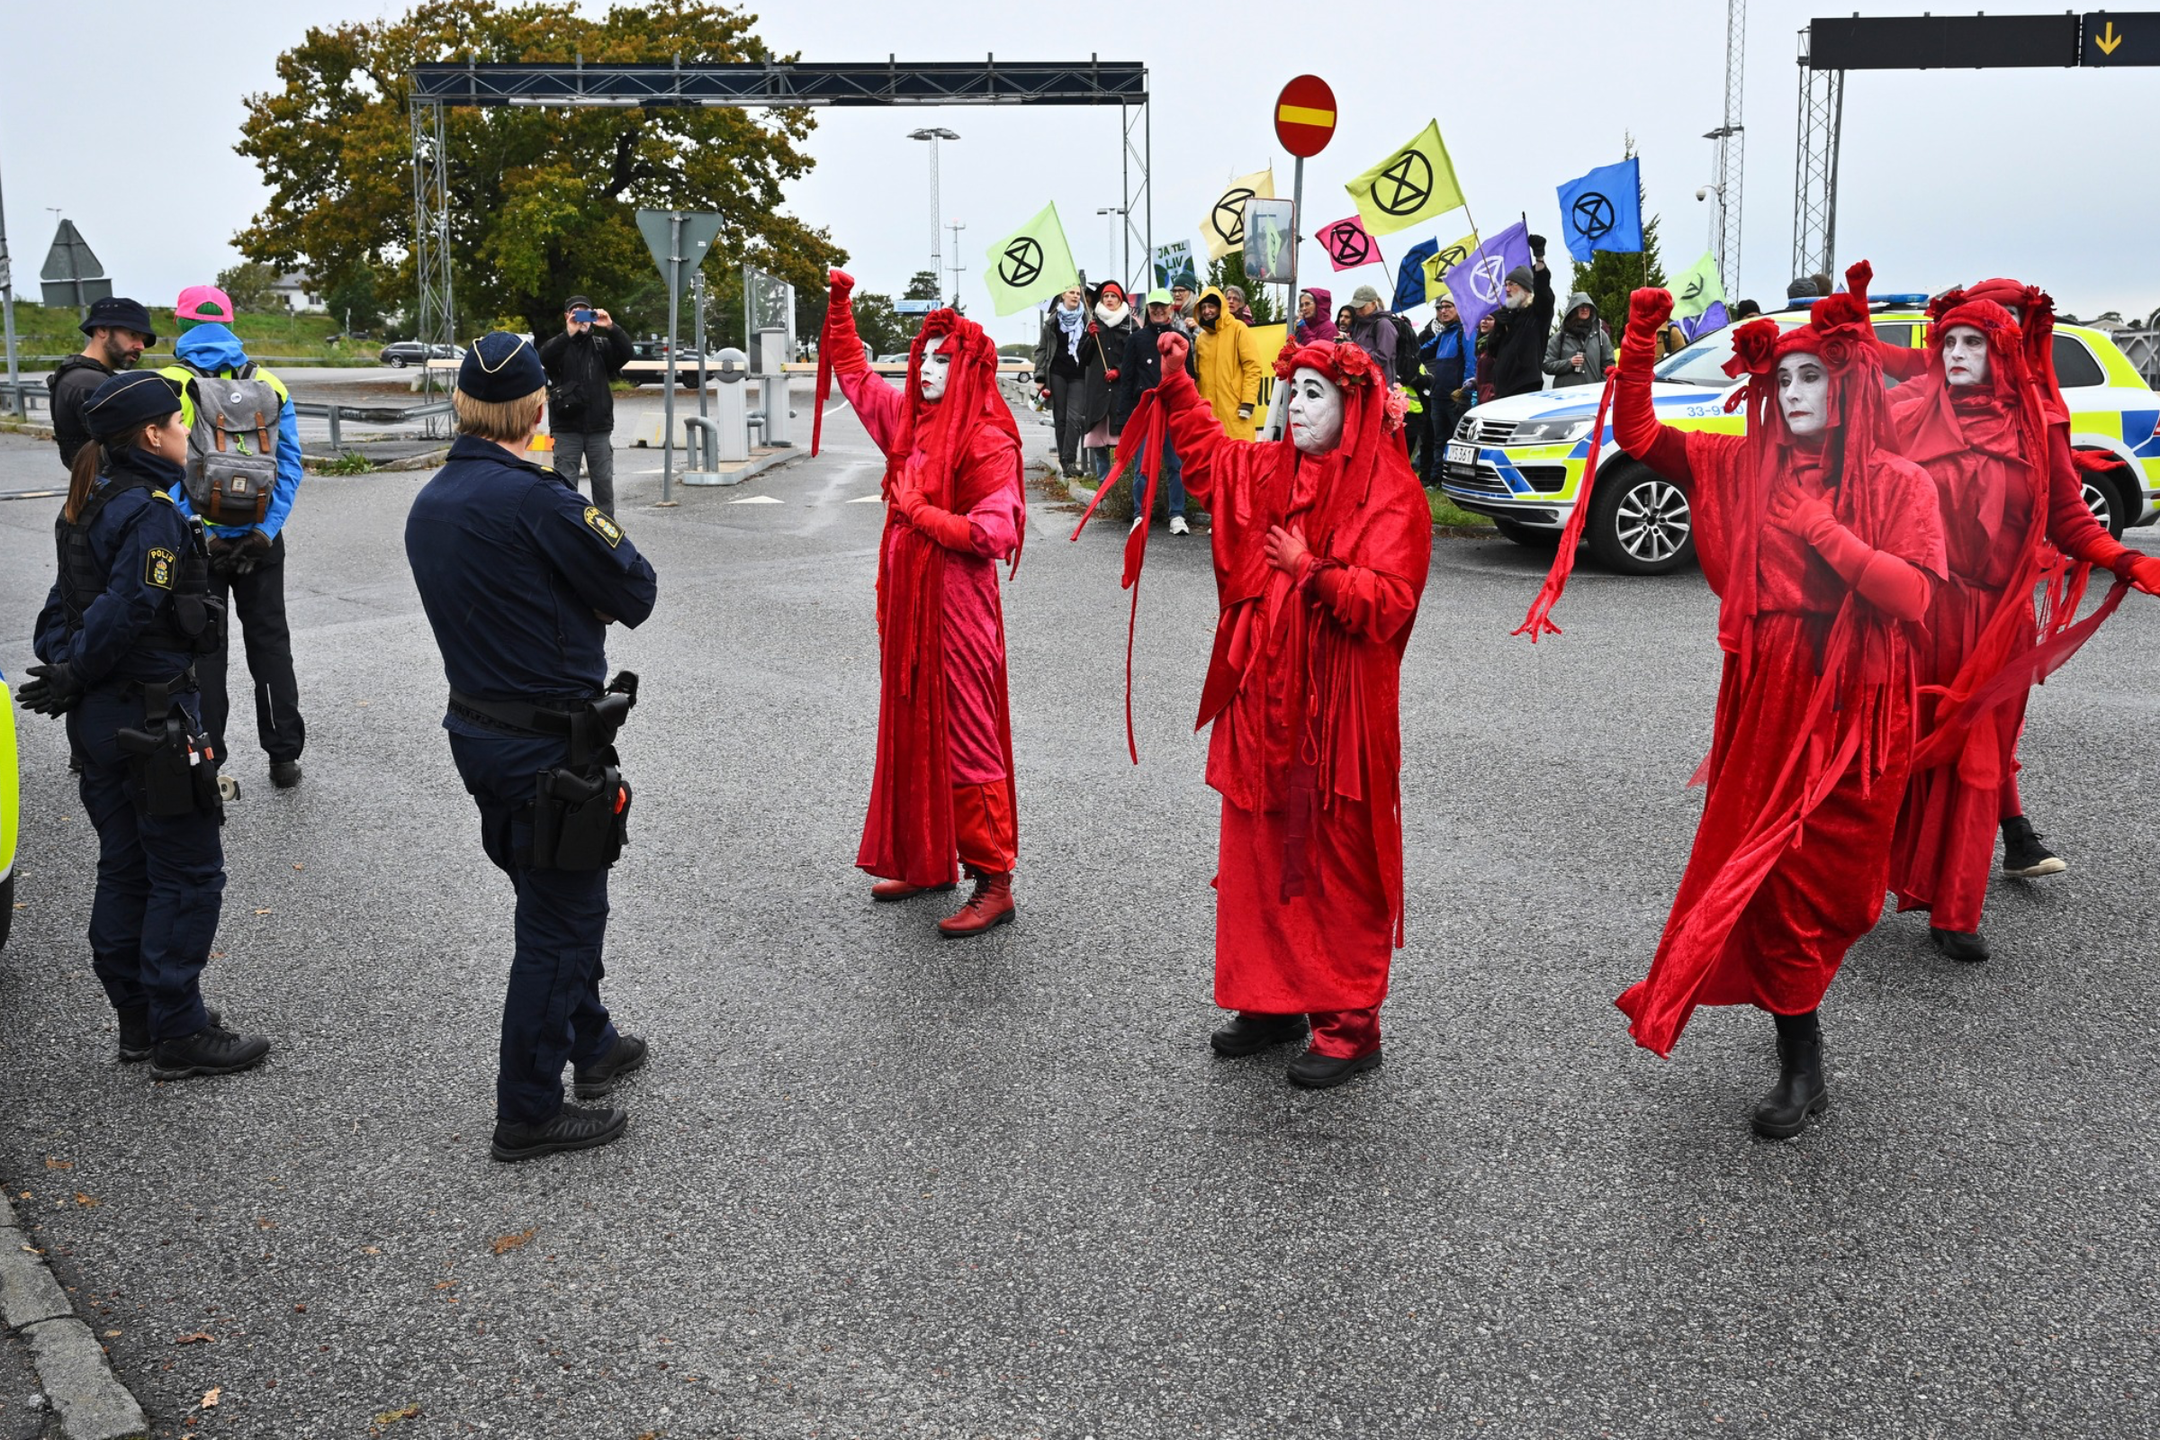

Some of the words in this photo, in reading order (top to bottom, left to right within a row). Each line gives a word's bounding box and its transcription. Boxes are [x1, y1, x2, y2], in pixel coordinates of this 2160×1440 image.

[1158, 246, 1170, 260] JA
[1171, 242, 1187, 254] TILL
[1165, 255, 1184, 270] LIV
[151, 549, 174, 563] POLIS
